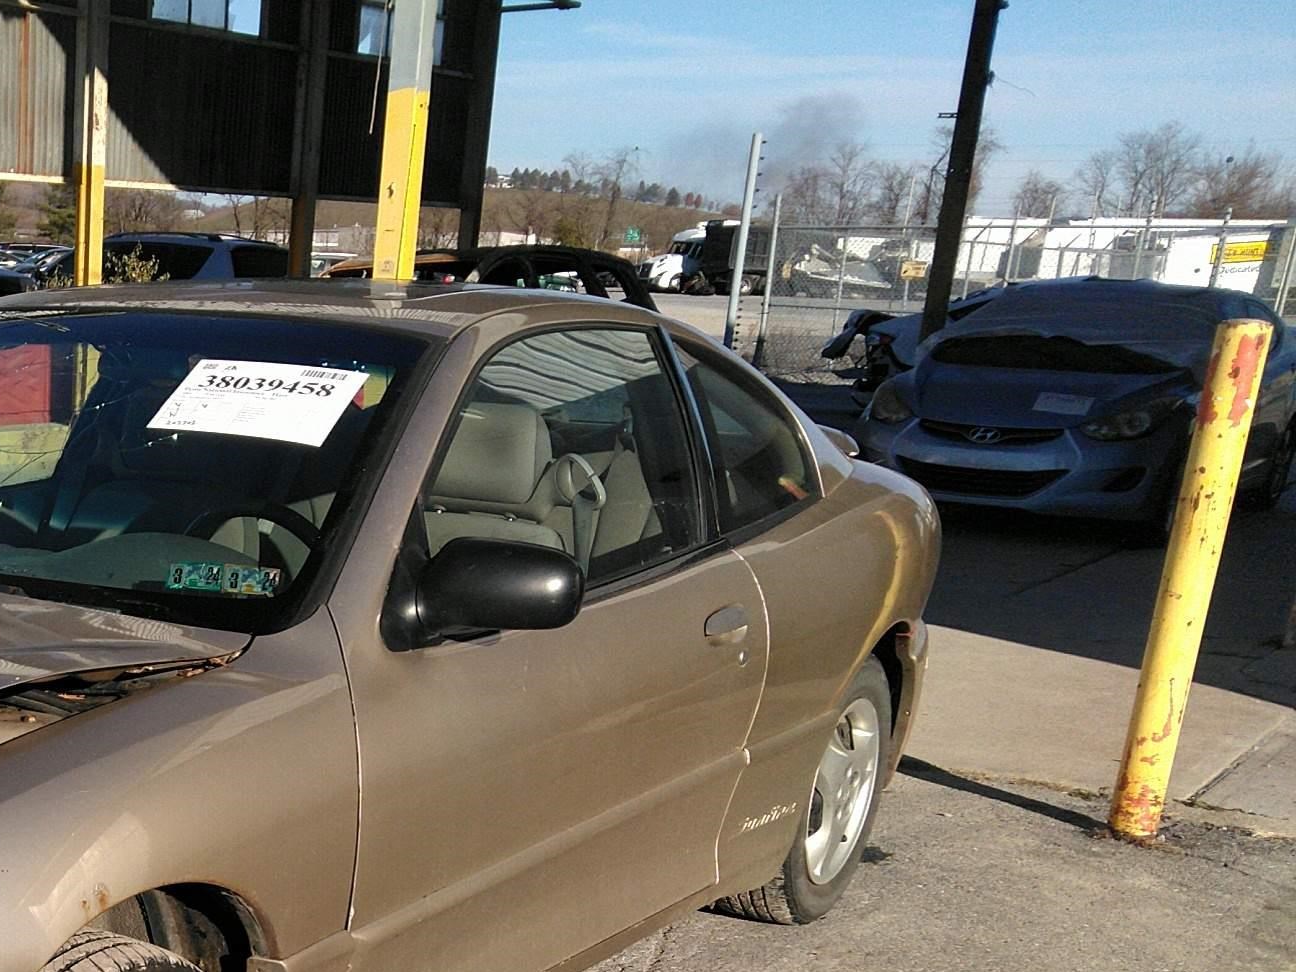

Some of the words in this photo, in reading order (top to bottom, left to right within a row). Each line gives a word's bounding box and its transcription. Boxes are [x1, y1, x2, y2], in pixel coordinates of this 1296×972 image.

[198, 374, 336, 398] 38039458
[173, 567, 184, 585] 3
[229, 571, 240, 589] 3
